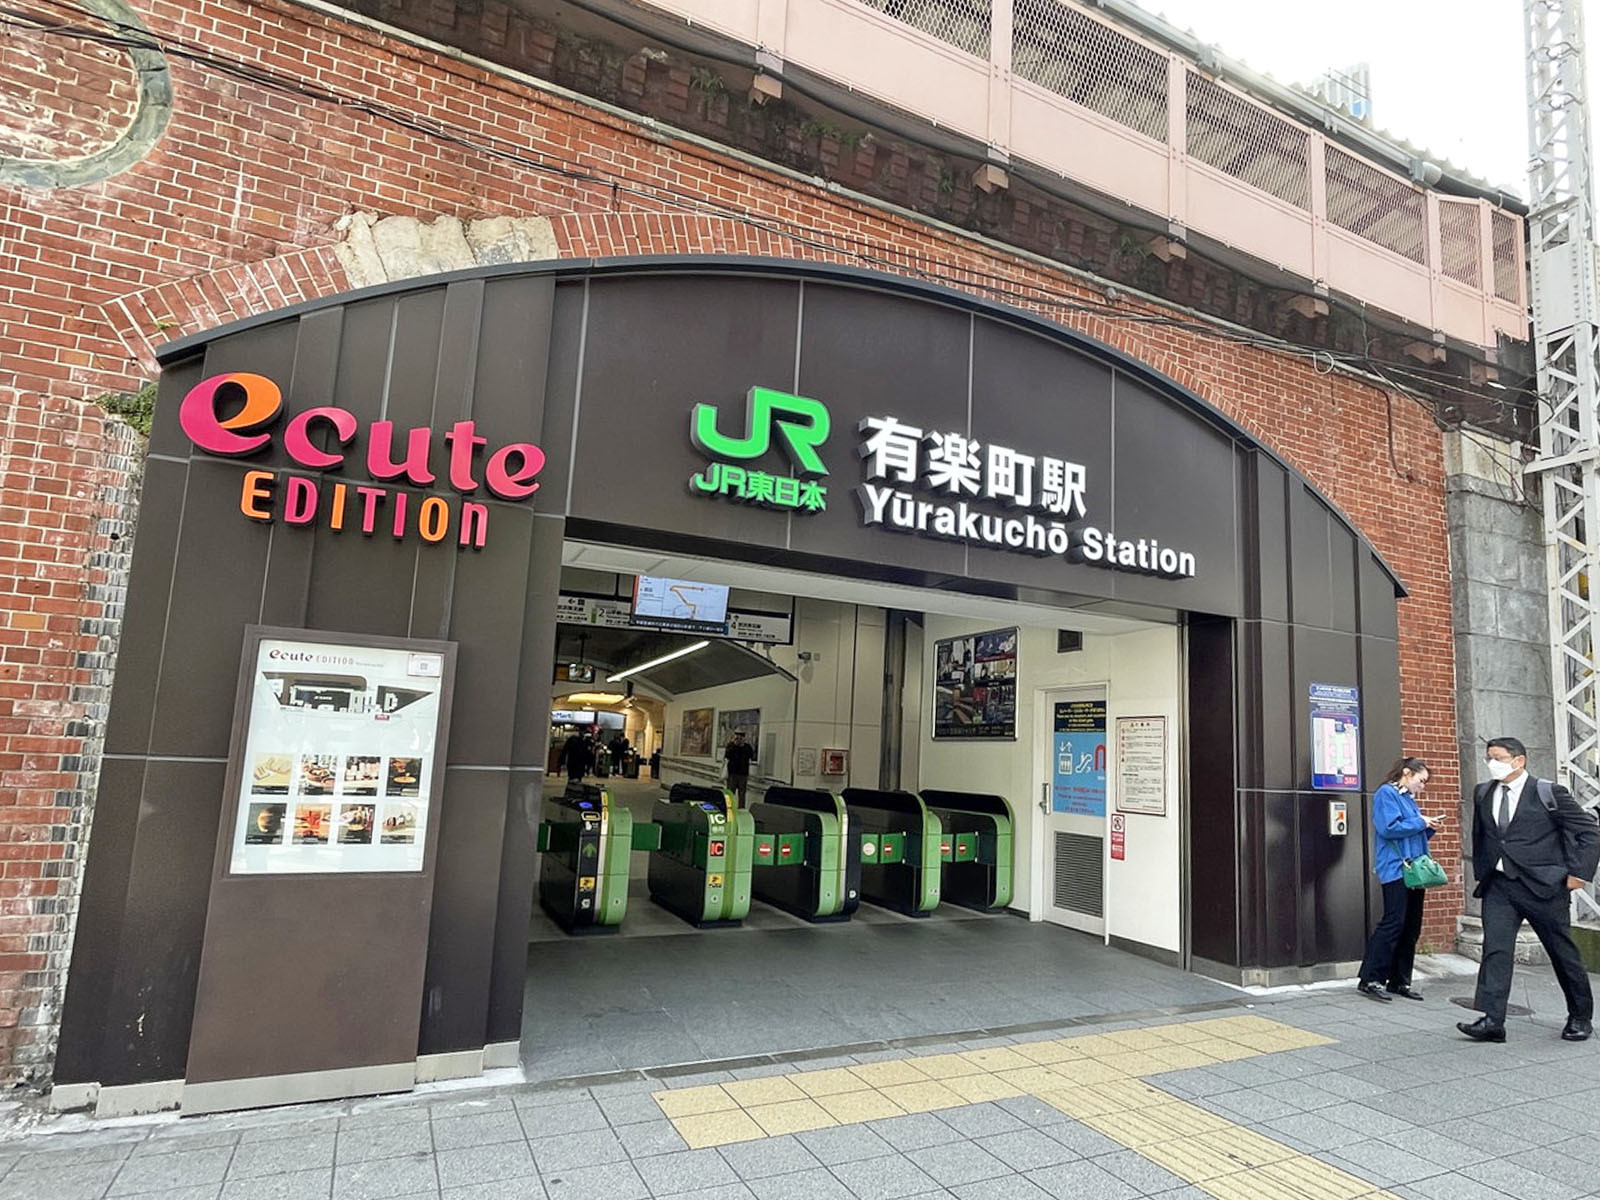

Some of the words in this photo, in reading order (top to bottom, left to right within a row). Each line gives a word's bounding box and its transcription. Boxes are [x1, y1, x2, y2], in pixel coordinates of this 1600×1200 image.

[179, 371, 545, 498] ecute
[690, 386, 831, 475] JR
[691, 463, 827, 513] JR東日本
[861, 416, 1087, 518] 有楽町駅
[862, 484, 1069, 555] Yūrakuchō
[1080, 526, 1195, 578] Station
[269, 649, 313, 662] ecute
[709, 813, 725, 825] IC
[710, 842, 723, 856] IC
